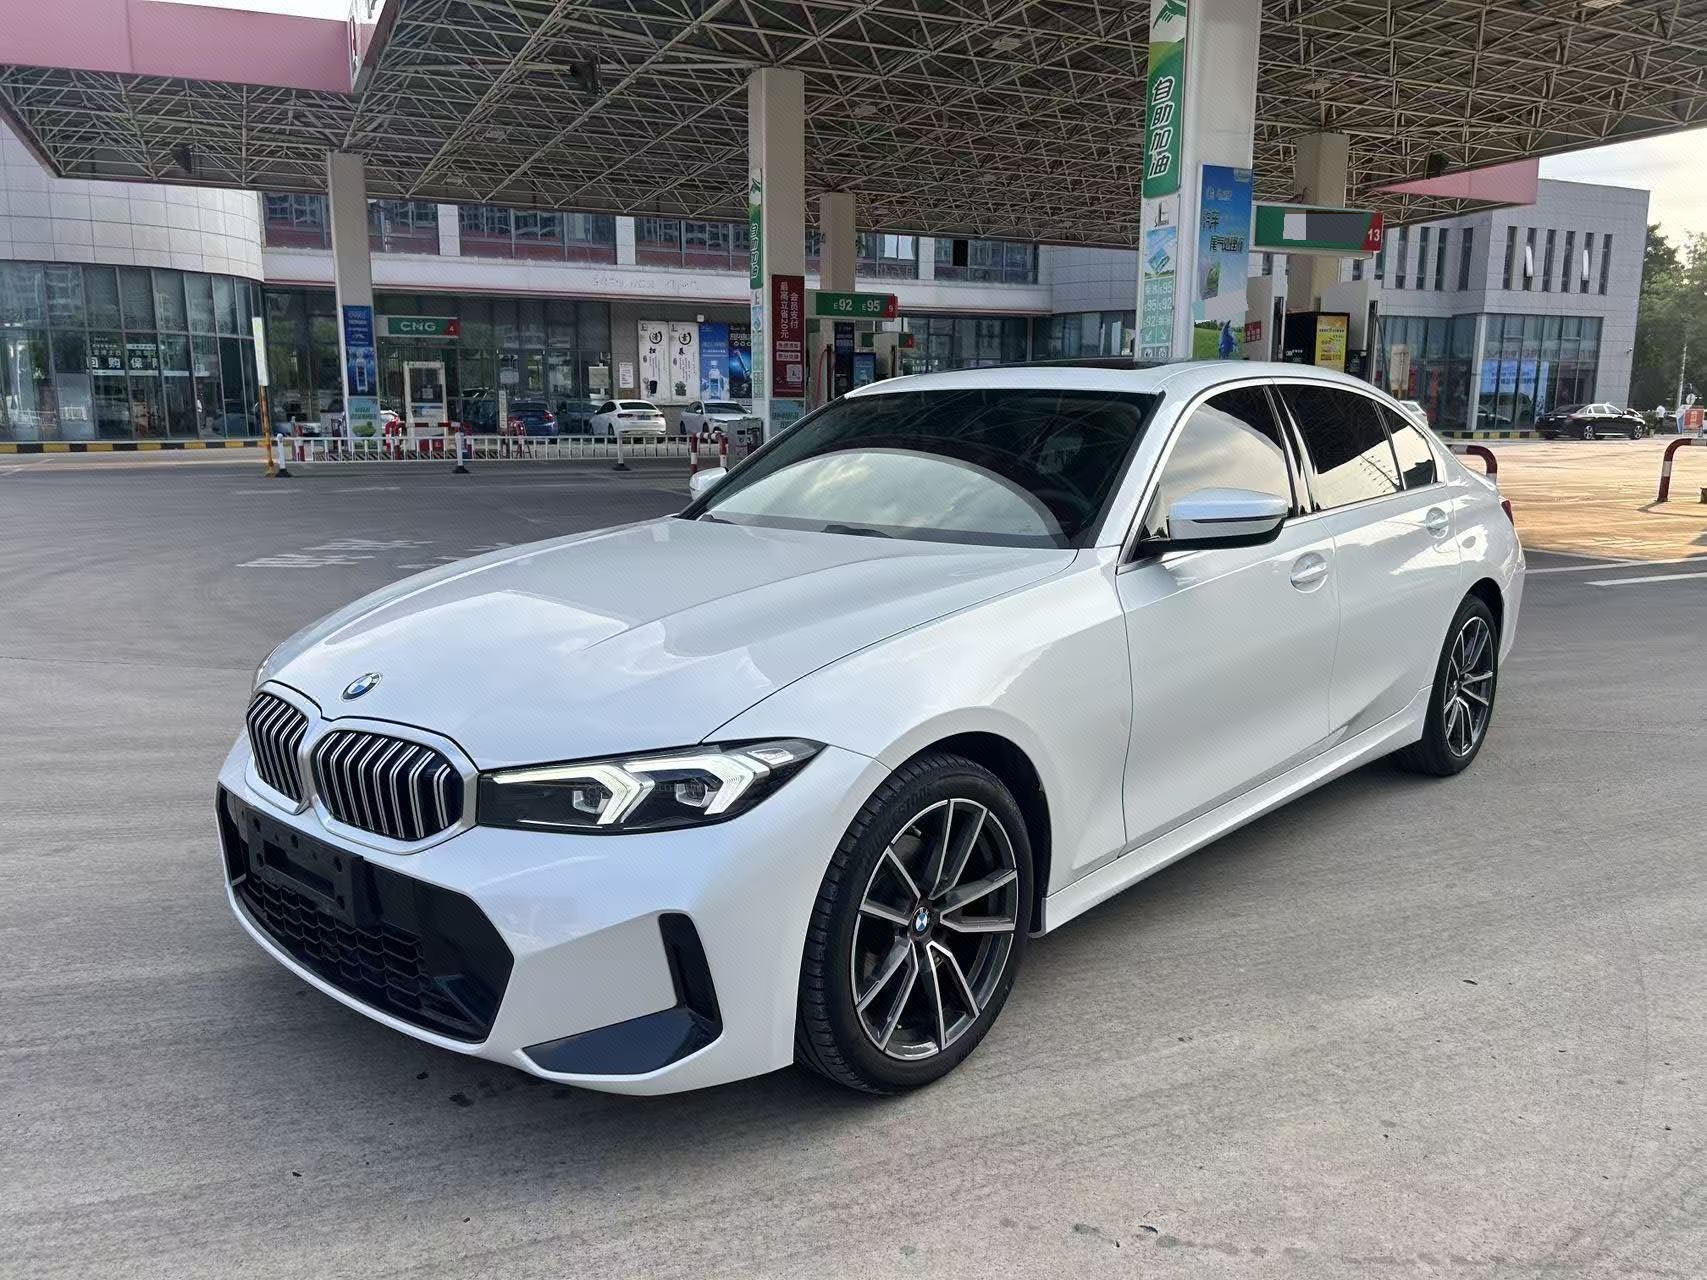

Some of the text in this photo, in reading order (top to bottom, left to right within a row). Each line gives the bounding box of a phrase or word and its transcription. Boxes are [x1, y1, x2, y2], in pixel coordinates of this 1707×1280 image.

[1147, 76, 1175, 179] 自助加油
[1367, 228, 1380, 242] 13
[789, 292, 800, 329] 会员支付
[833, 299, 881, 312] E92 E95
[888, 305, 894, 313] 9
[400, 321, 436, 331] CNG
